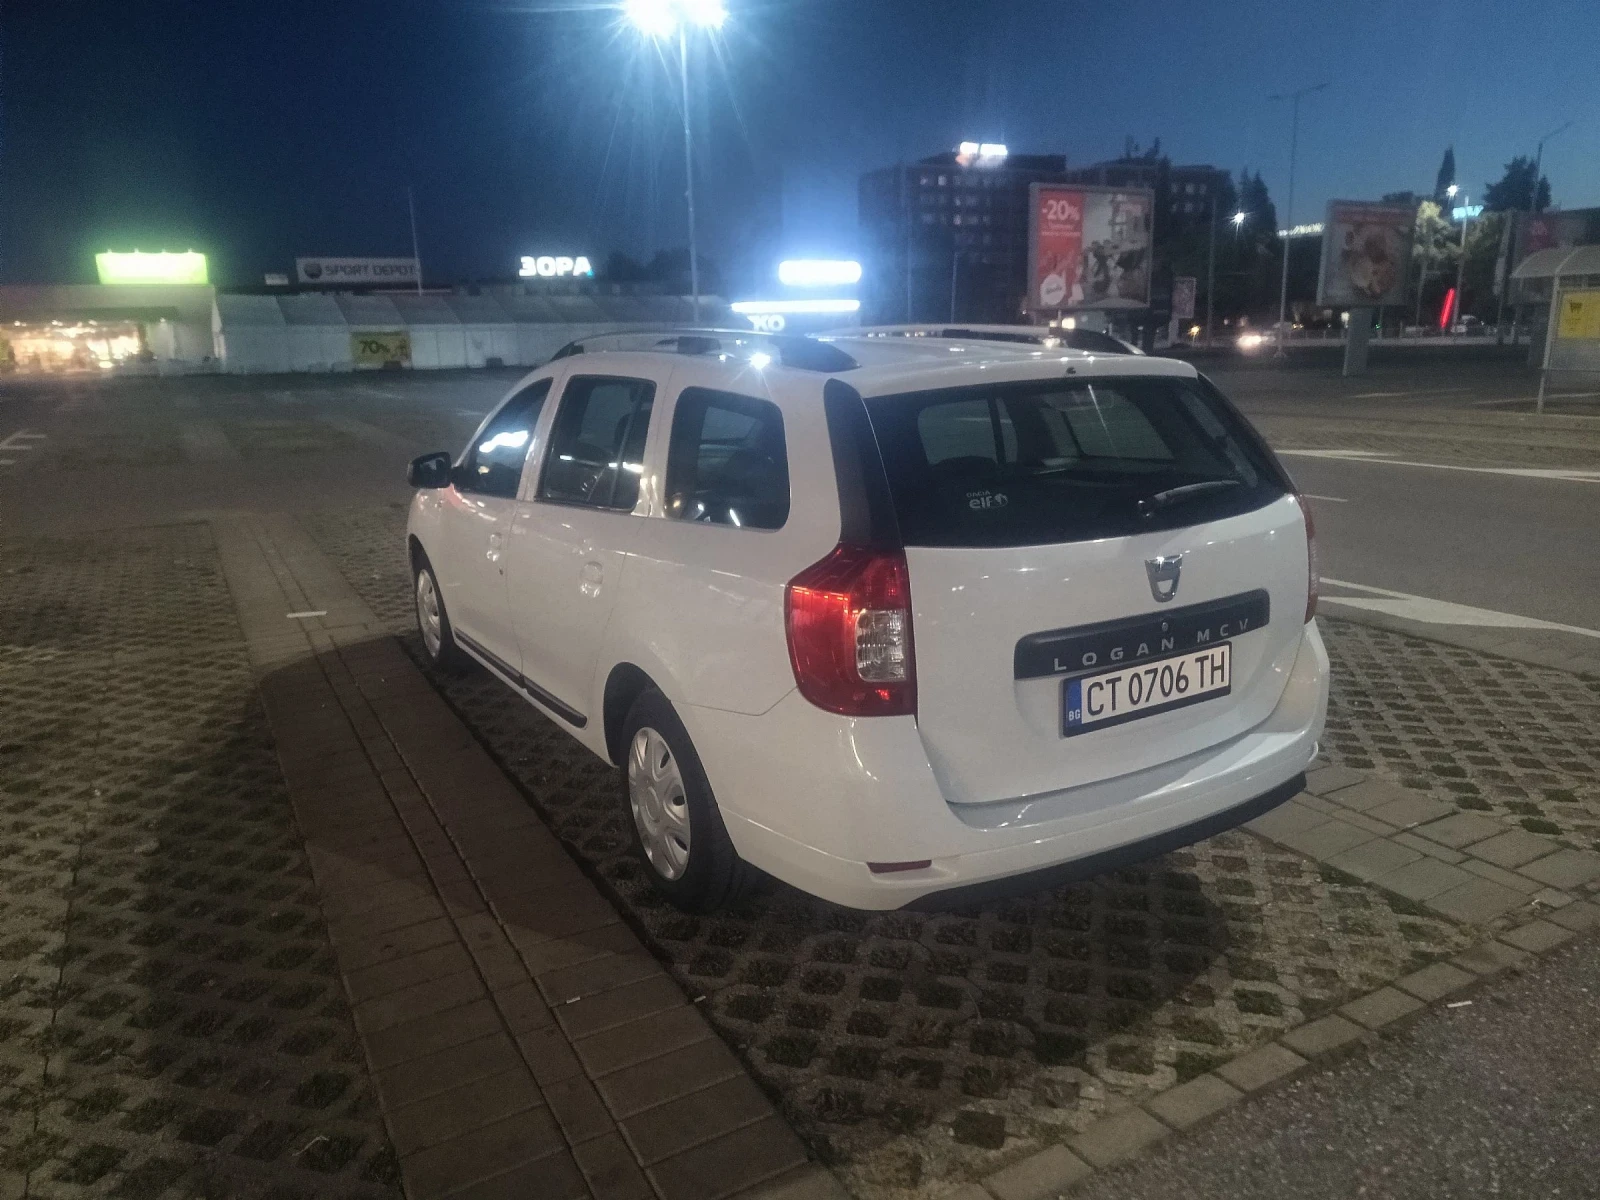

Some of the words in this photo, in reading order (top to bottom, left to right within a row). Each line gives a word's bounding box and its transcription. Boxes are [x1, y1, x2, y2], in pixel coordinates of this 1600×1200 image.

[1042, 199, 1081, 221] -20%
[325, 264, 368, 276] SPORT
[969, 495, 993, 509] elf
[1054, 637, 1174, 672] LOGAN
[1197, 618, 1249, 644] MCV
[1087, 676, 1122, 716] CT
[1128, 660, 1189, 706] 0706
[1195, 651, 1225, 695] TH
[1068, 708, 1081, 723] BG
